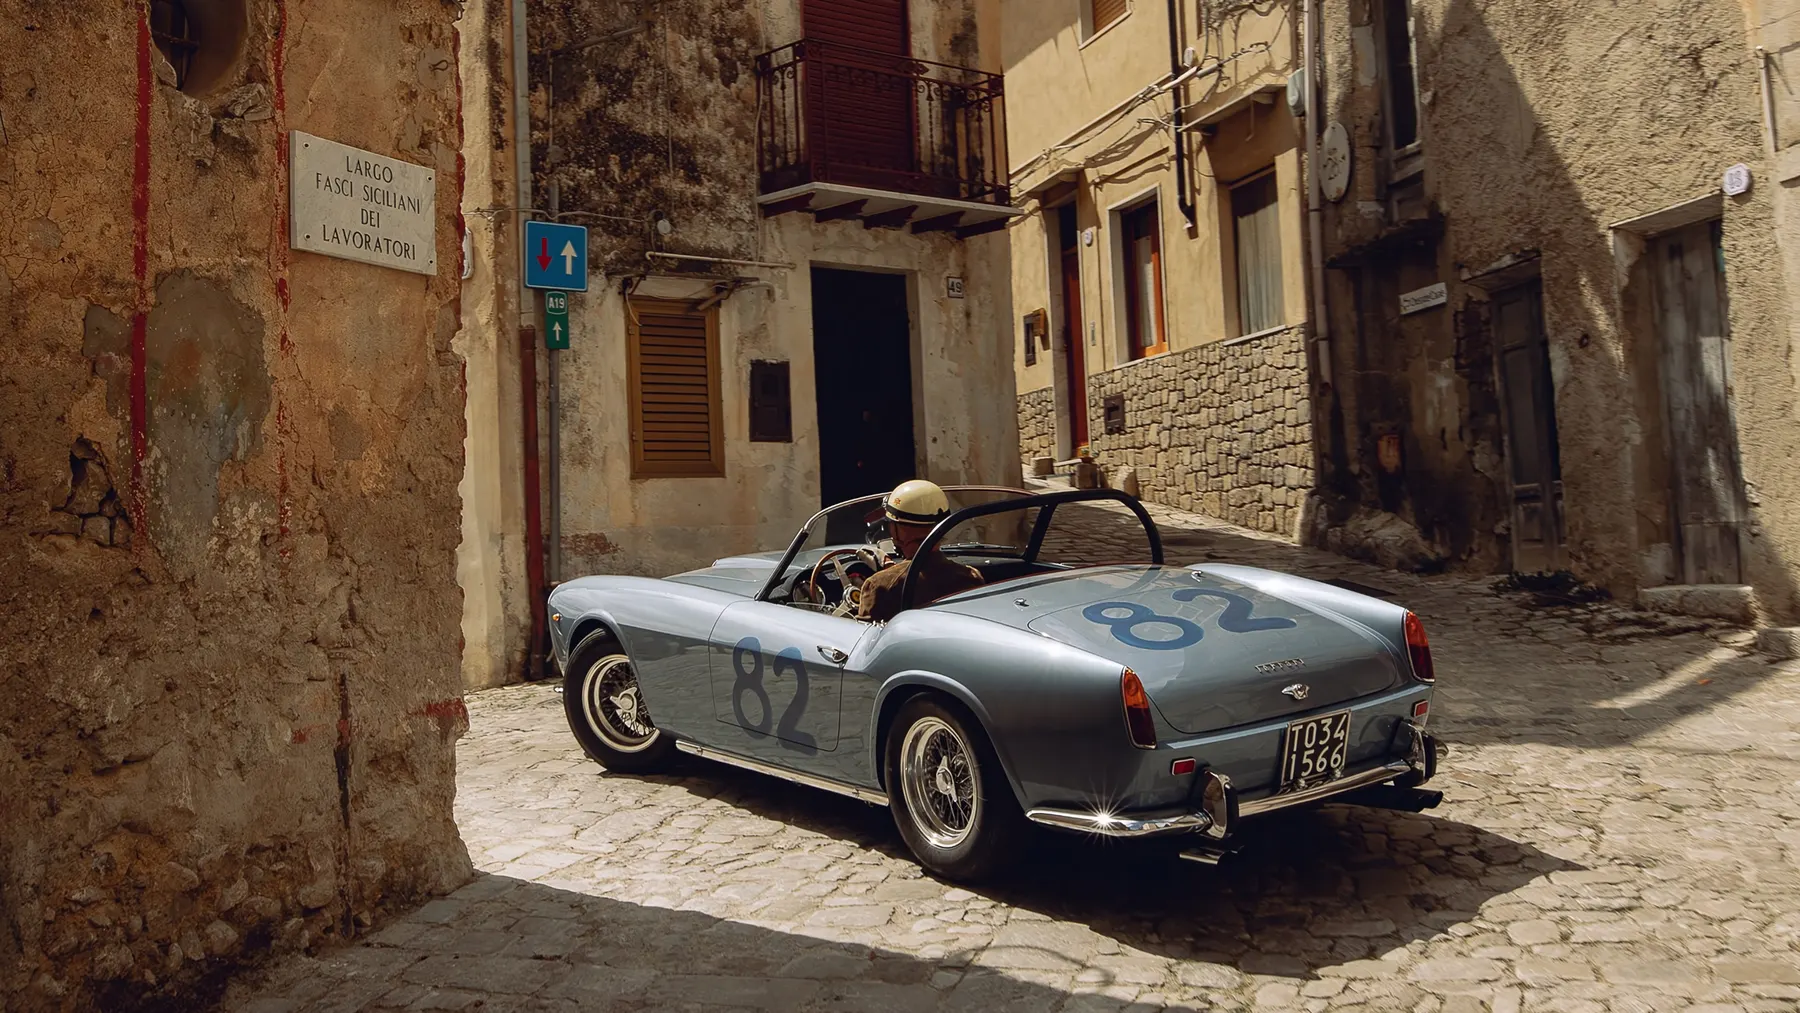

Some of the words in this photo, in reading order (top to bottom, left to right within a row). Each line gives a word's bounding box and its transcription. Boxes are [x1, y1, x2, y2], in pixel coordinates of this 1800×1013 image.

[346, 155, 393, 183] LARGO
[316, 172, 353, 197] FASCI
[363, 184, 420, 214] SICILIANI
[361, 208, 380, 228] DEI
[322, 224, 416, 260] LAVORATORI
[548, 297, 565, 309] A19
[948, 281, 962, 293] 49
[1082, 588, 1298, 650] 82
[733, 636, 818, 756] 82
[1289, 742, 1344, 780] 1566
